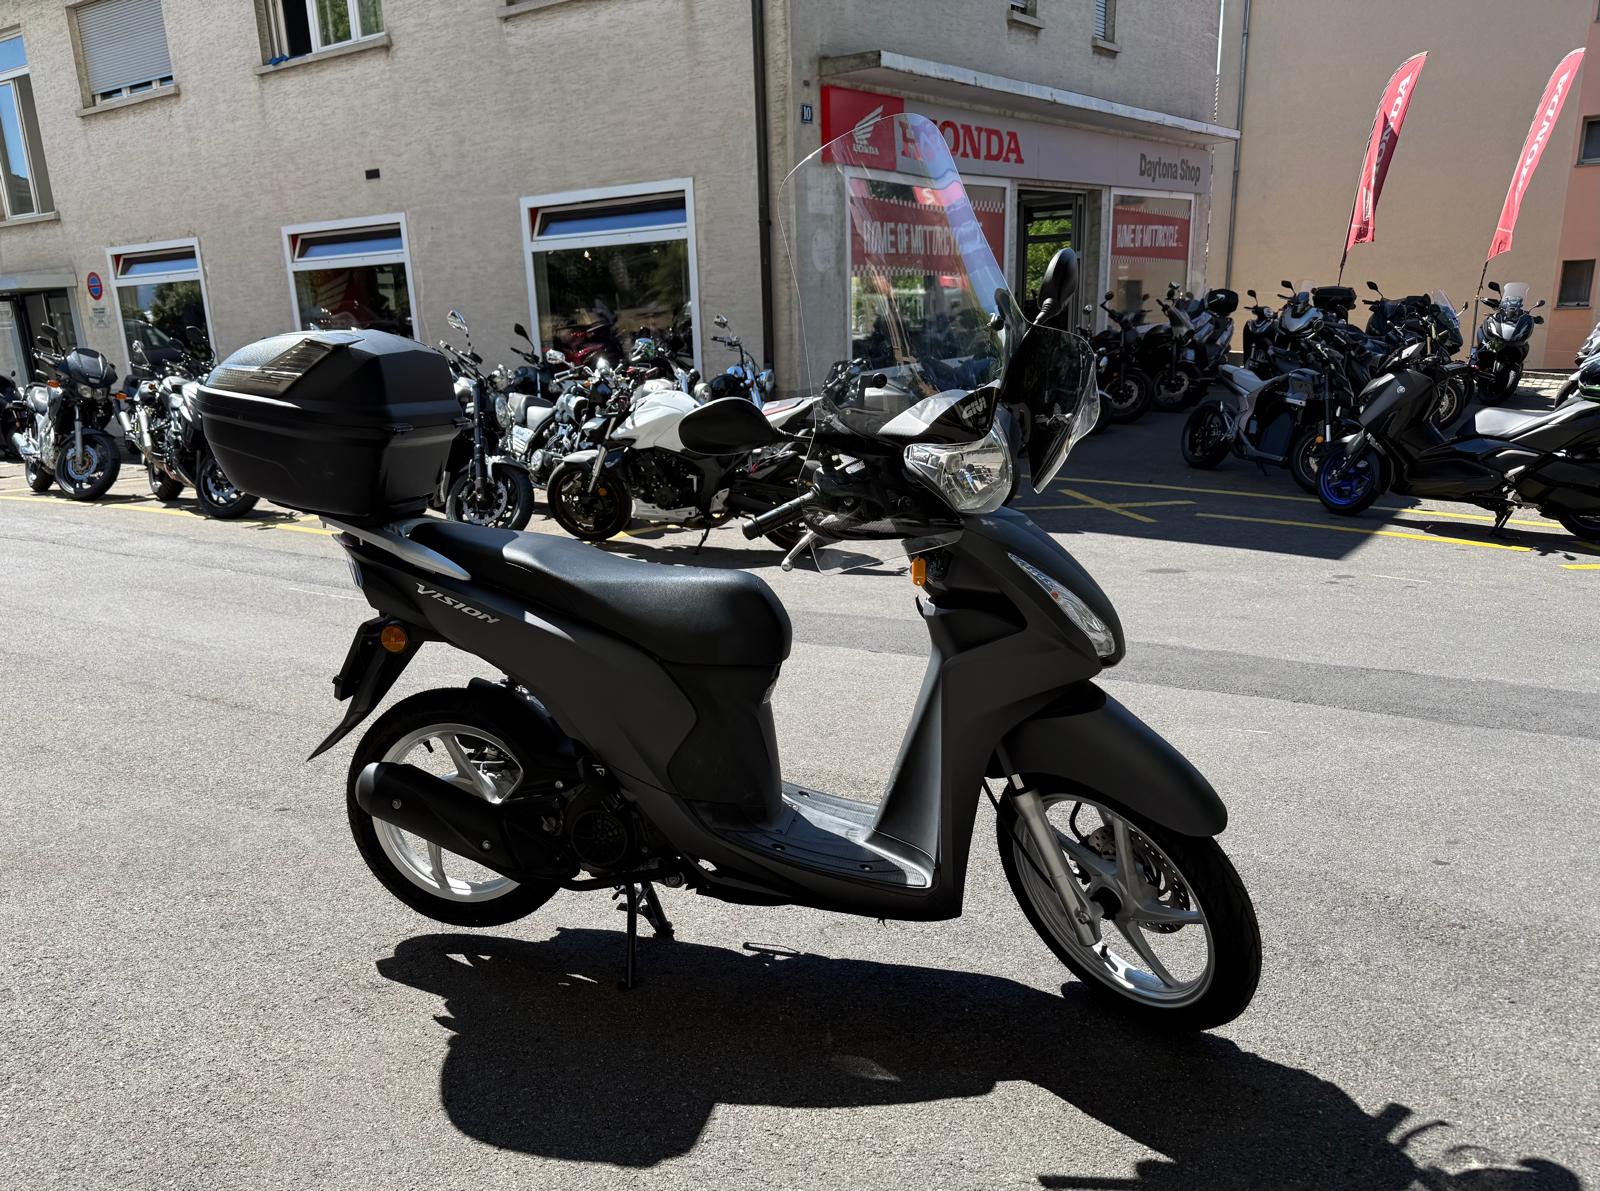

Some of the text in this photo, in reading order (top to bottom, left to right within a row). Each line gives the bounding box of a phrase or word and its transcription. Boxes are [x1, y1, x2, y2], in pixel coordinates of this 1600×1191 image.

[803, 106, 812, 120] 10
[853, 143, 880, 156] HONDA
[1140, 153, 1200, 186] Daytona Shop
[863, 220, 896, 254] HOME
[897, 222, 910, 254] OF
[1116, 224, 1135, 248] HOME
[1135, 225, 1143, 248] OF
[962, 396, 987, 419] GIVI
[416, 582, 500, 623] VISION
